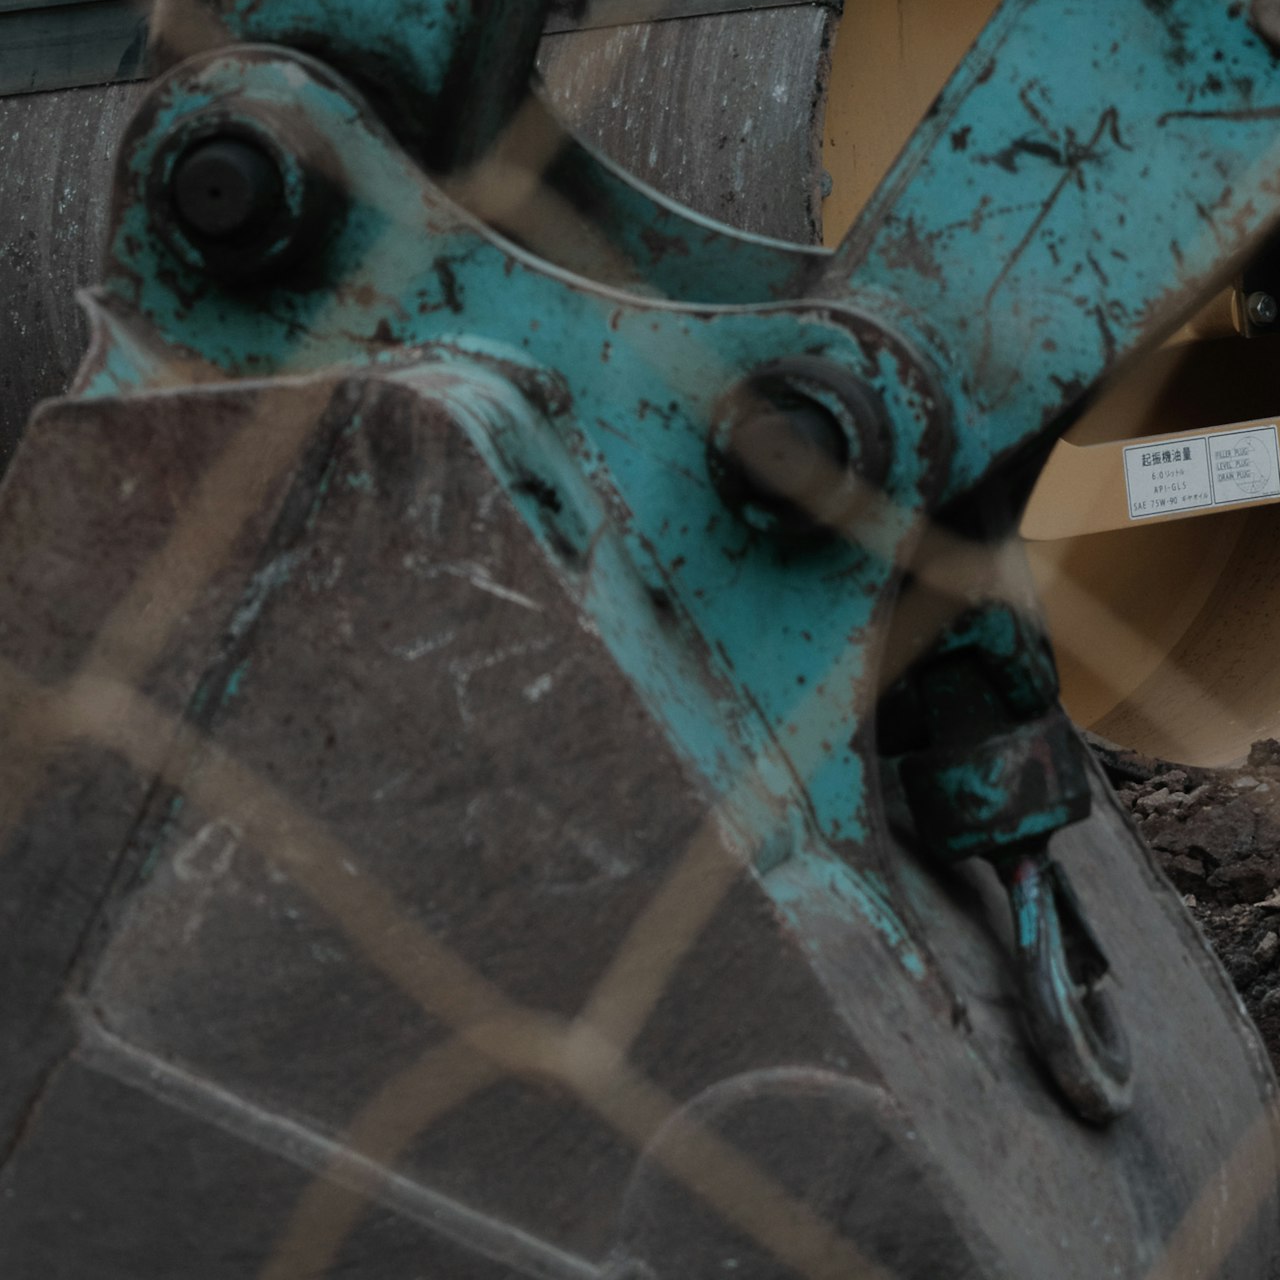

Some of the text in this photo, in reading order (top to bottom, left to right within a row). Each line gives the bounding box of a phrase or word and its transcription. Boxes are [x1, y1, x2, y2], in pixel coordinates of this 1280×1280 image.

[1142, 447, 1192, 467] 起振機油量
[1134, 501, 1147, 511] SAE
